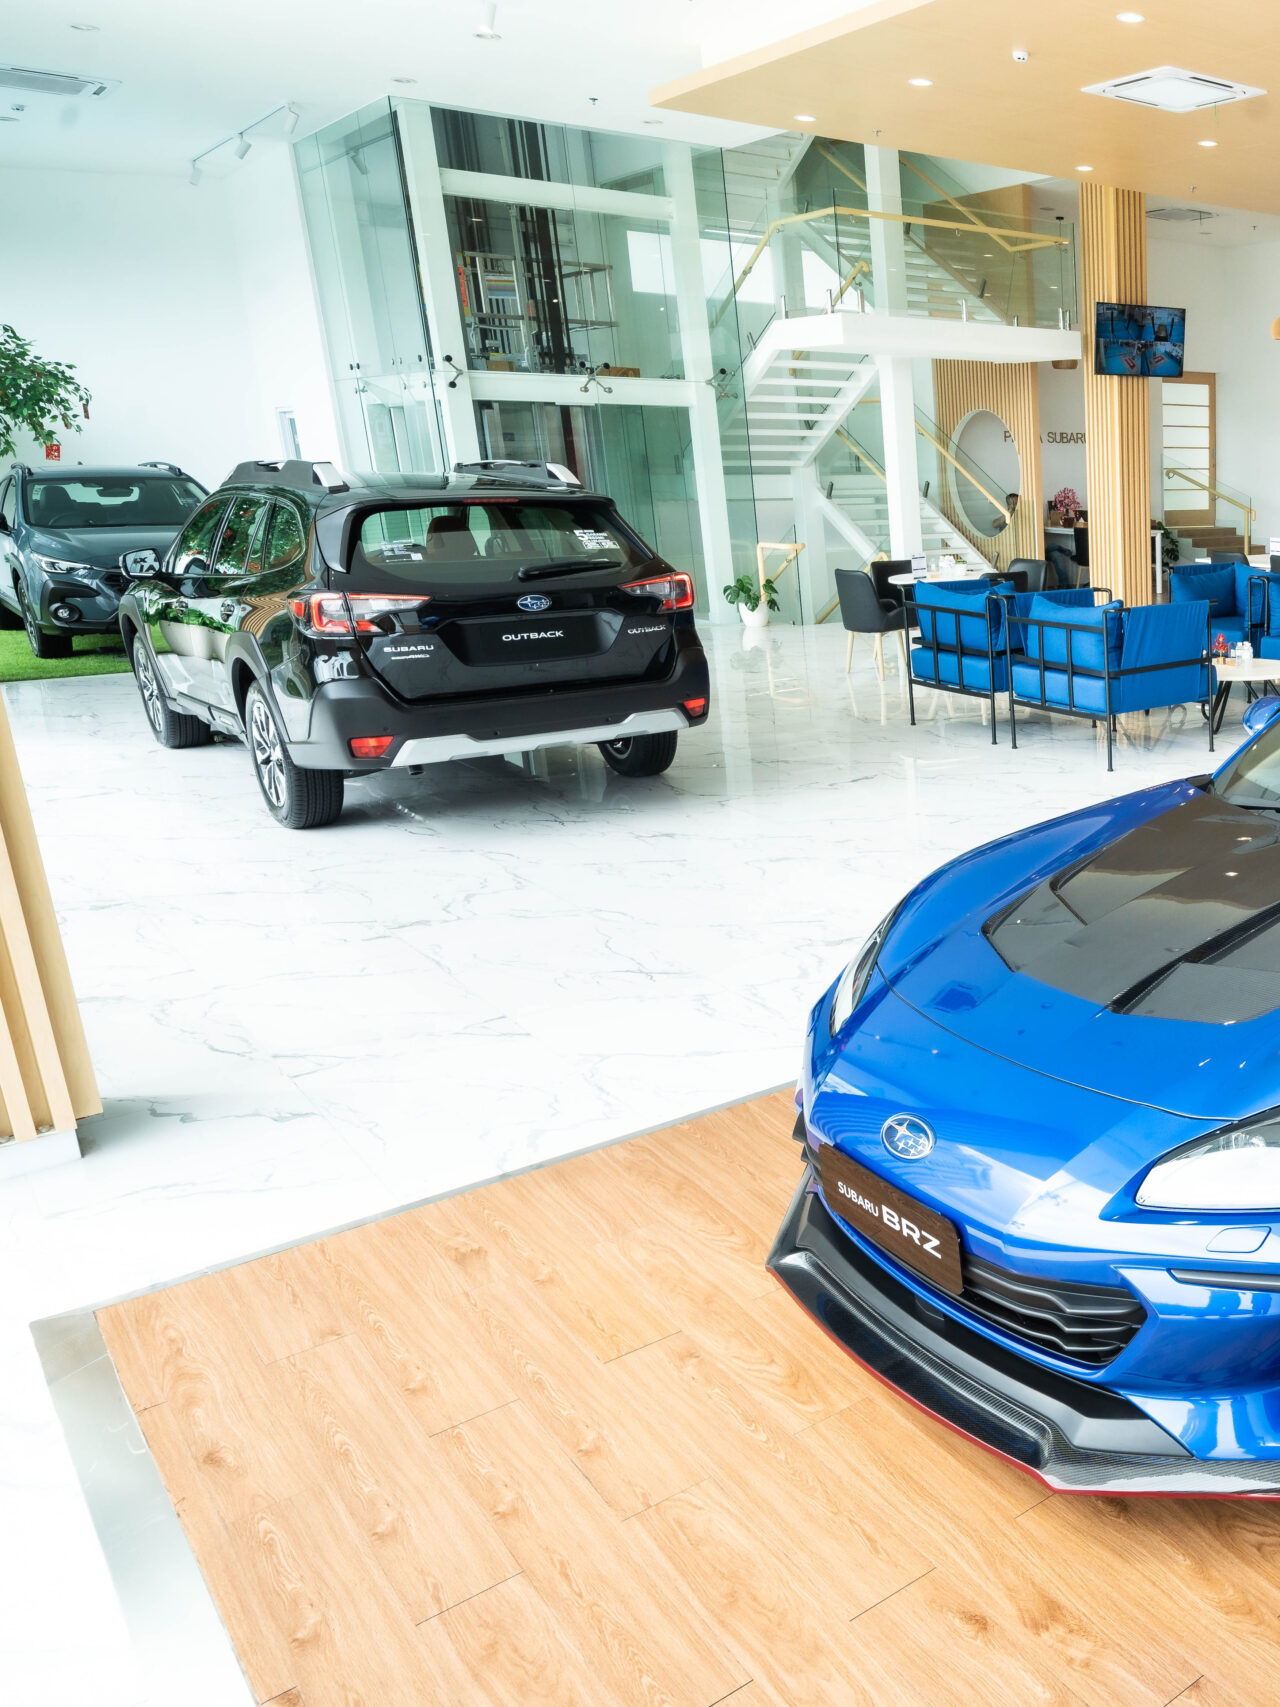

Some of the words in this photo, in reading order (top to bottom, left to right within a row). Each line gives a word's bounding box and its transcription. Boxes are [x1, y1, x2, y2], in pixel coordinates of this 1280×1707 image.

[627, 624, 667, 635] OUTBACK
[502, 630, 564, 641] OUTBACK
[383, 644, 434, 653] SUBARU
[837, 1180, 879, 1217] SUBARU
[881, 1203, 942, 1260] BRZ
